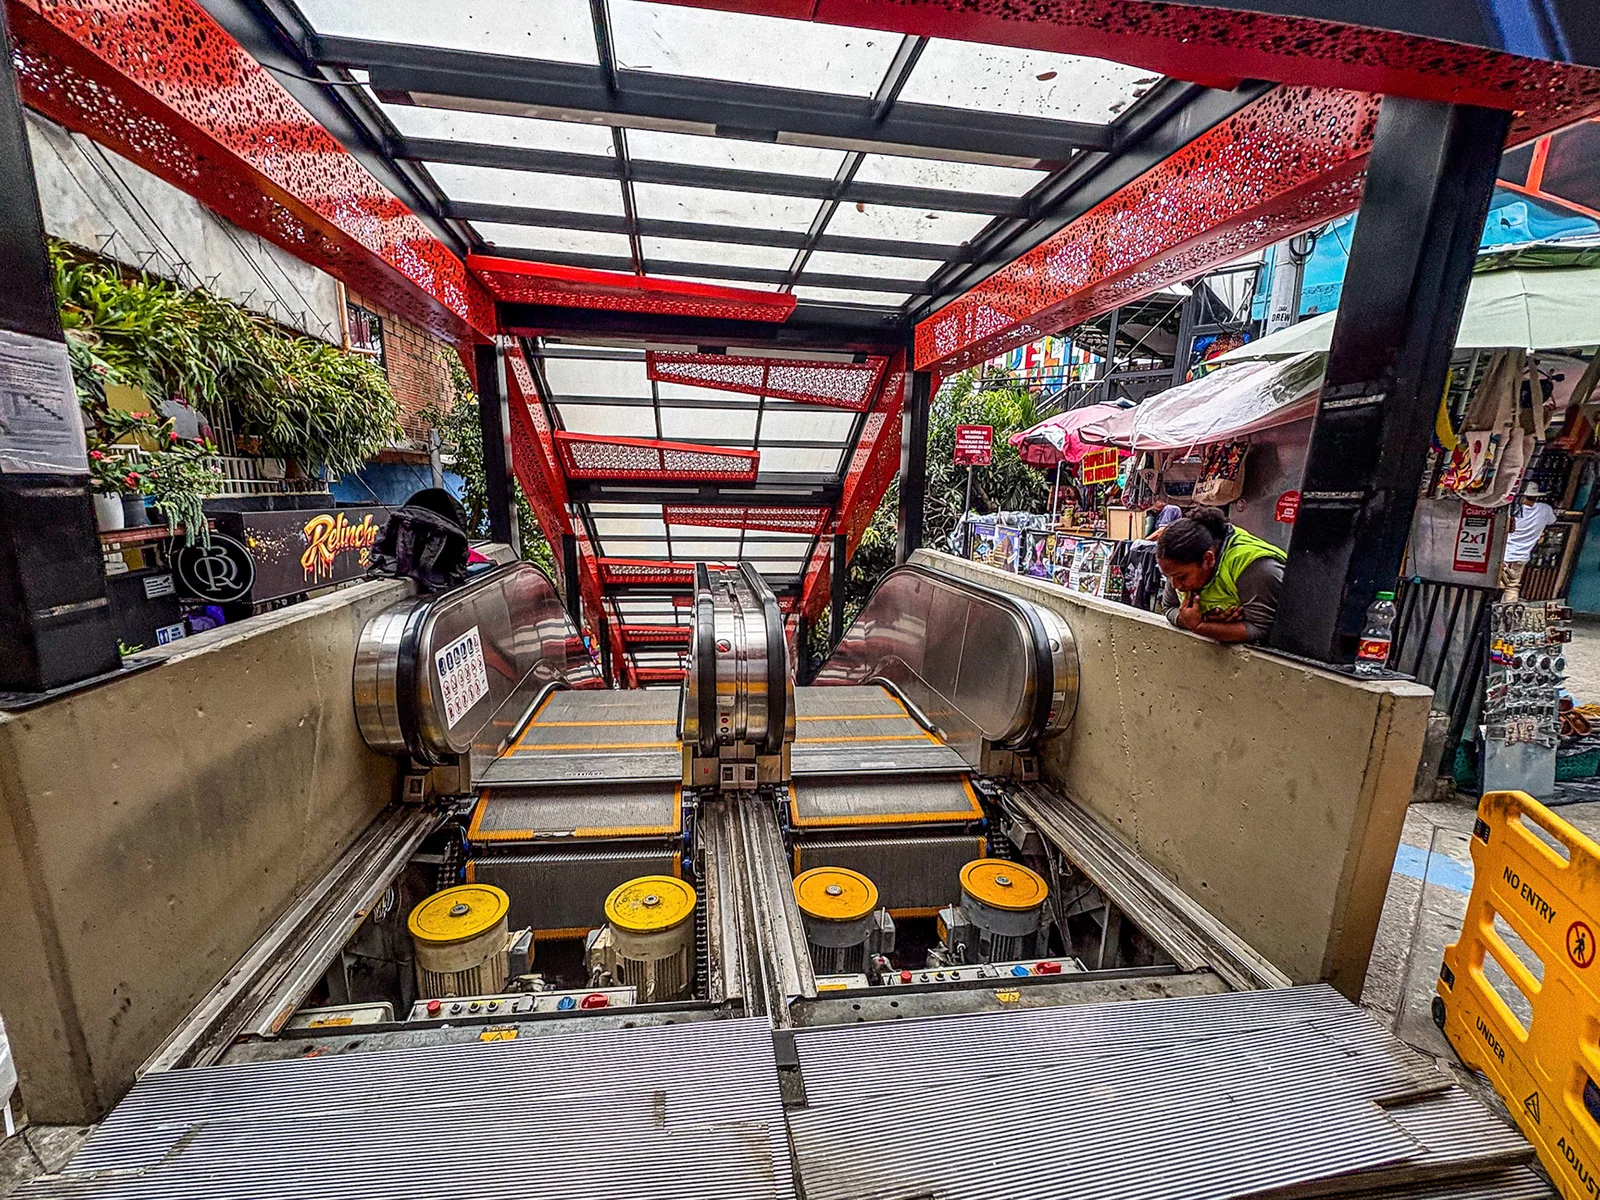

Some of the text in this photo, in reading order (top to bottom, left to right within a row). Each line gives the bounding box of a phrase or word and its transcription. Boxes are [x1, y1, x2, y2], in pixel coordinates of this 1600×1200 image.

[1271, 312, 1291, 323] DREW
[1465, 507, 1488, 516] Claro
[1459, 530, 1487, 545] 2x1
[1502, 865, 1557, 925] NO ENTRY
[1476, 1015, 1506, 1065] UNDER
